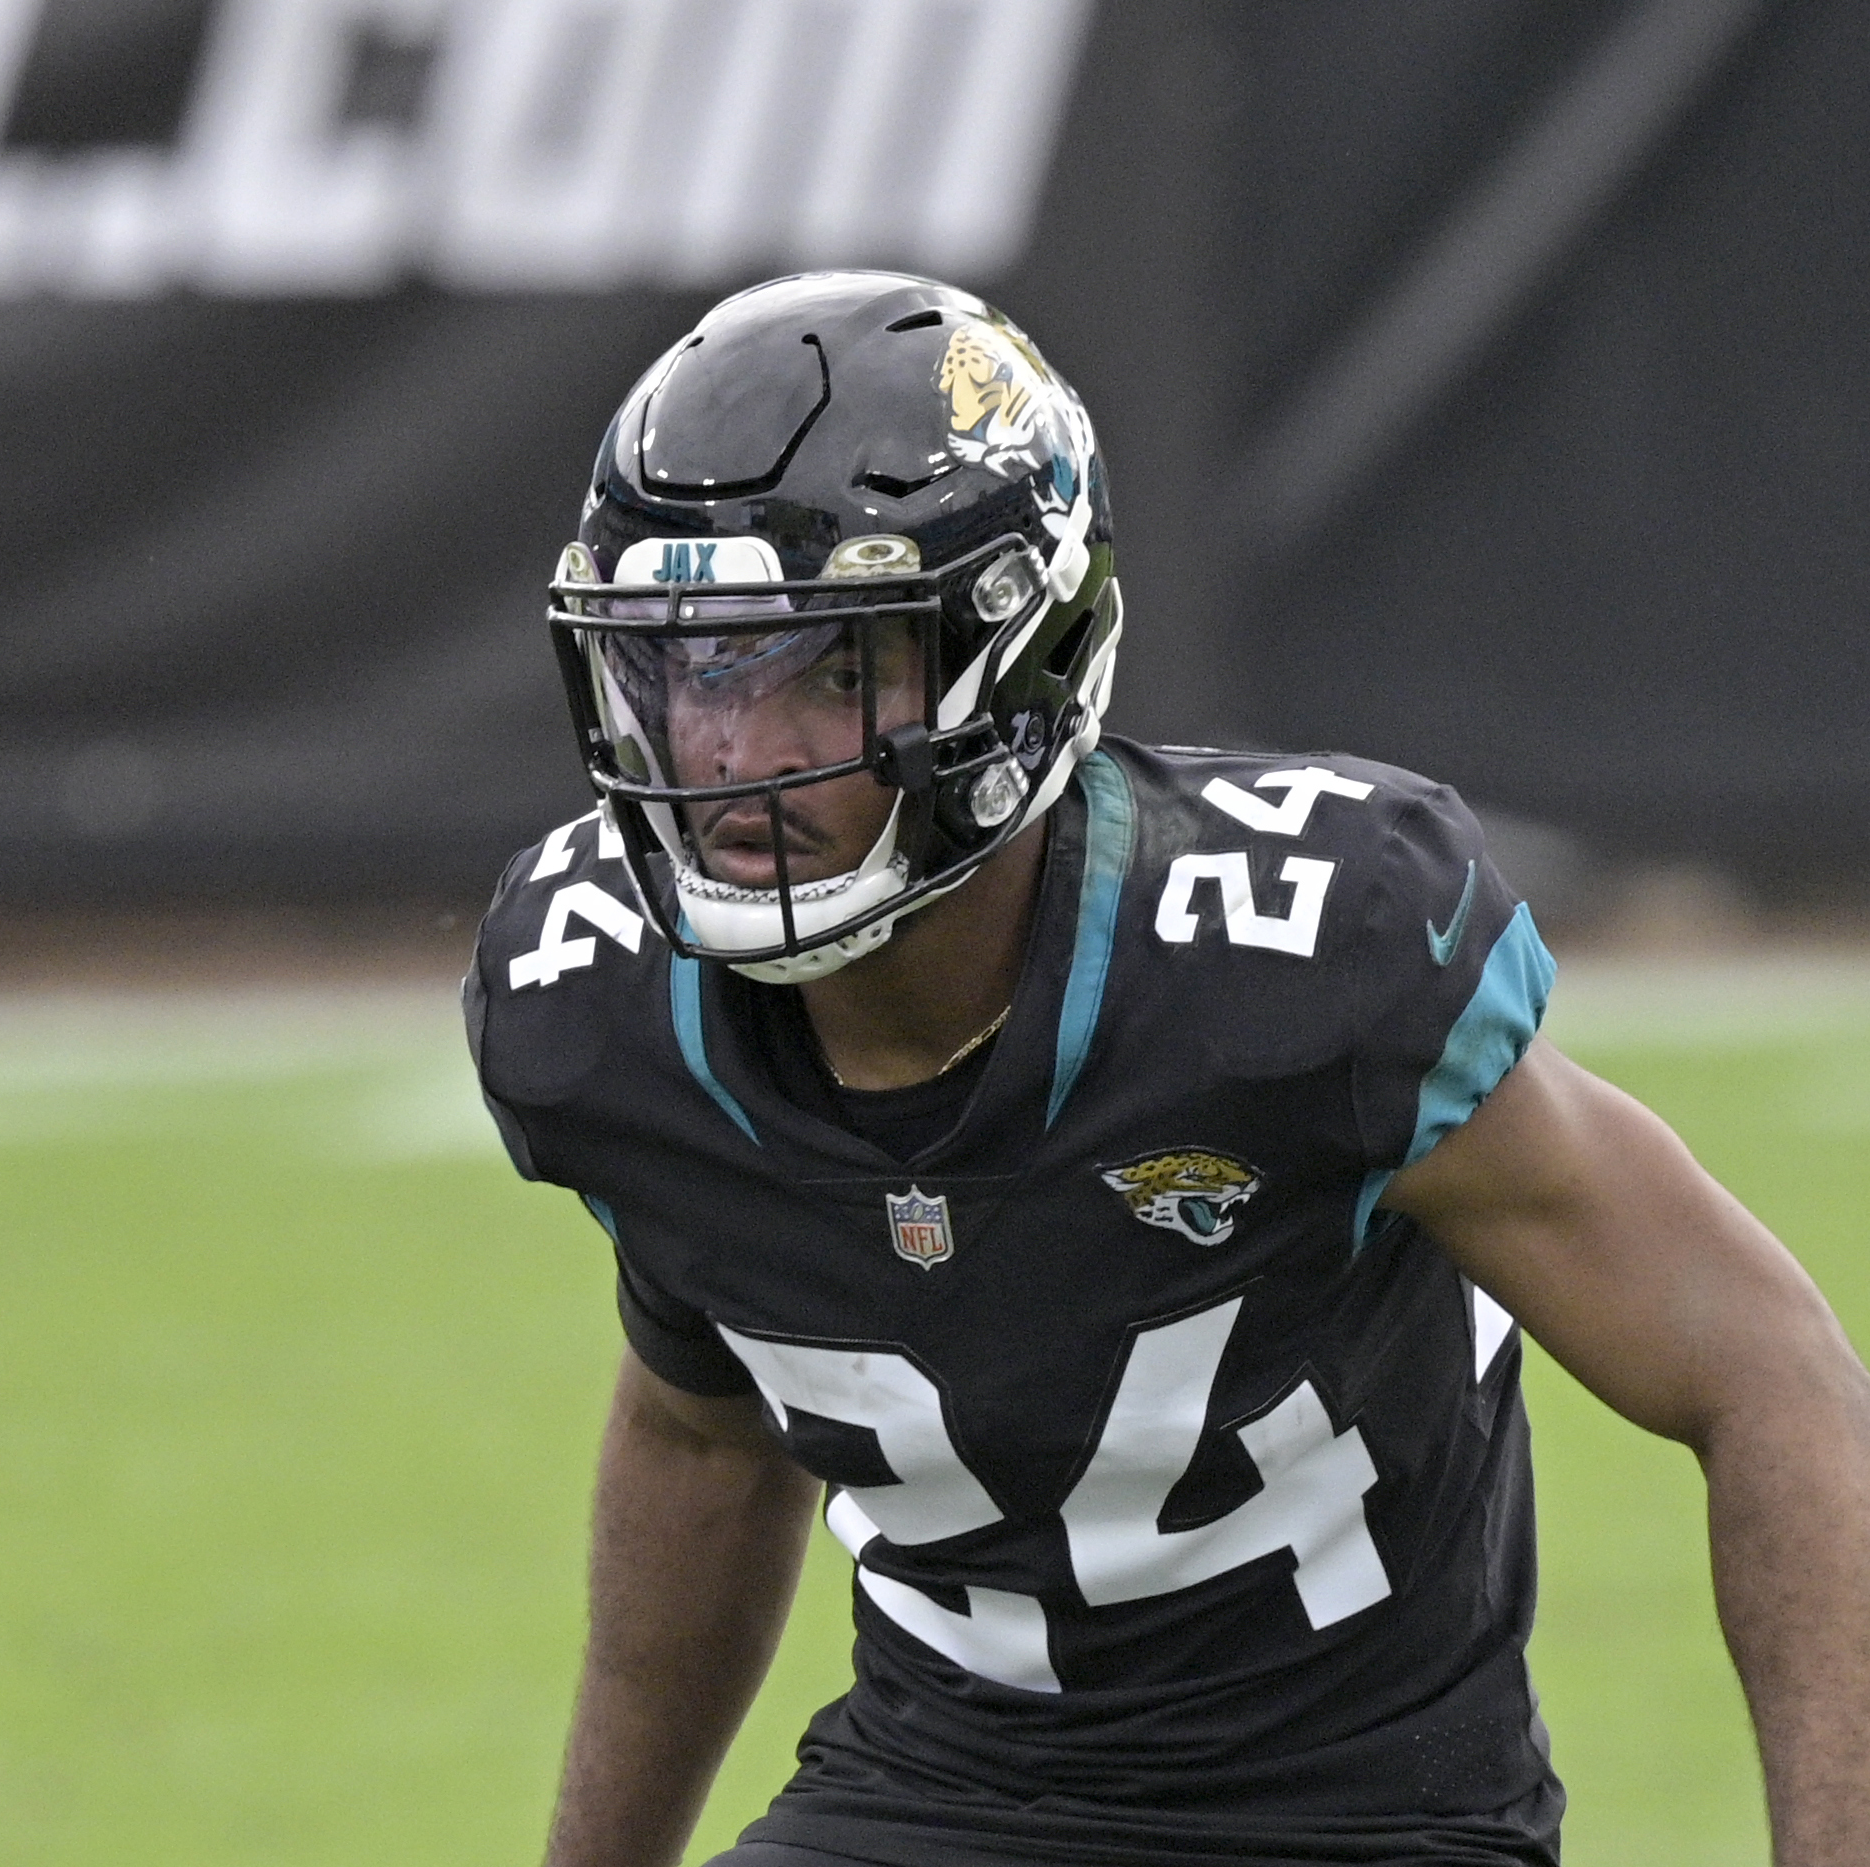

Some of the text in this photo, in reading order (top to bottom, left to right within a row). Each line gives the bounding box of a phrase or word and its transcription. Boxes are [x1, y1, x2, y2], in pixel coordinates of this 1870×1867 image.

[652, 543, 717, 583] JAX
[1155, 766, 1376, 957] 24
[899, 1224, 943, 1256] NFL
[716, 1295, 1393, 1694] 24
